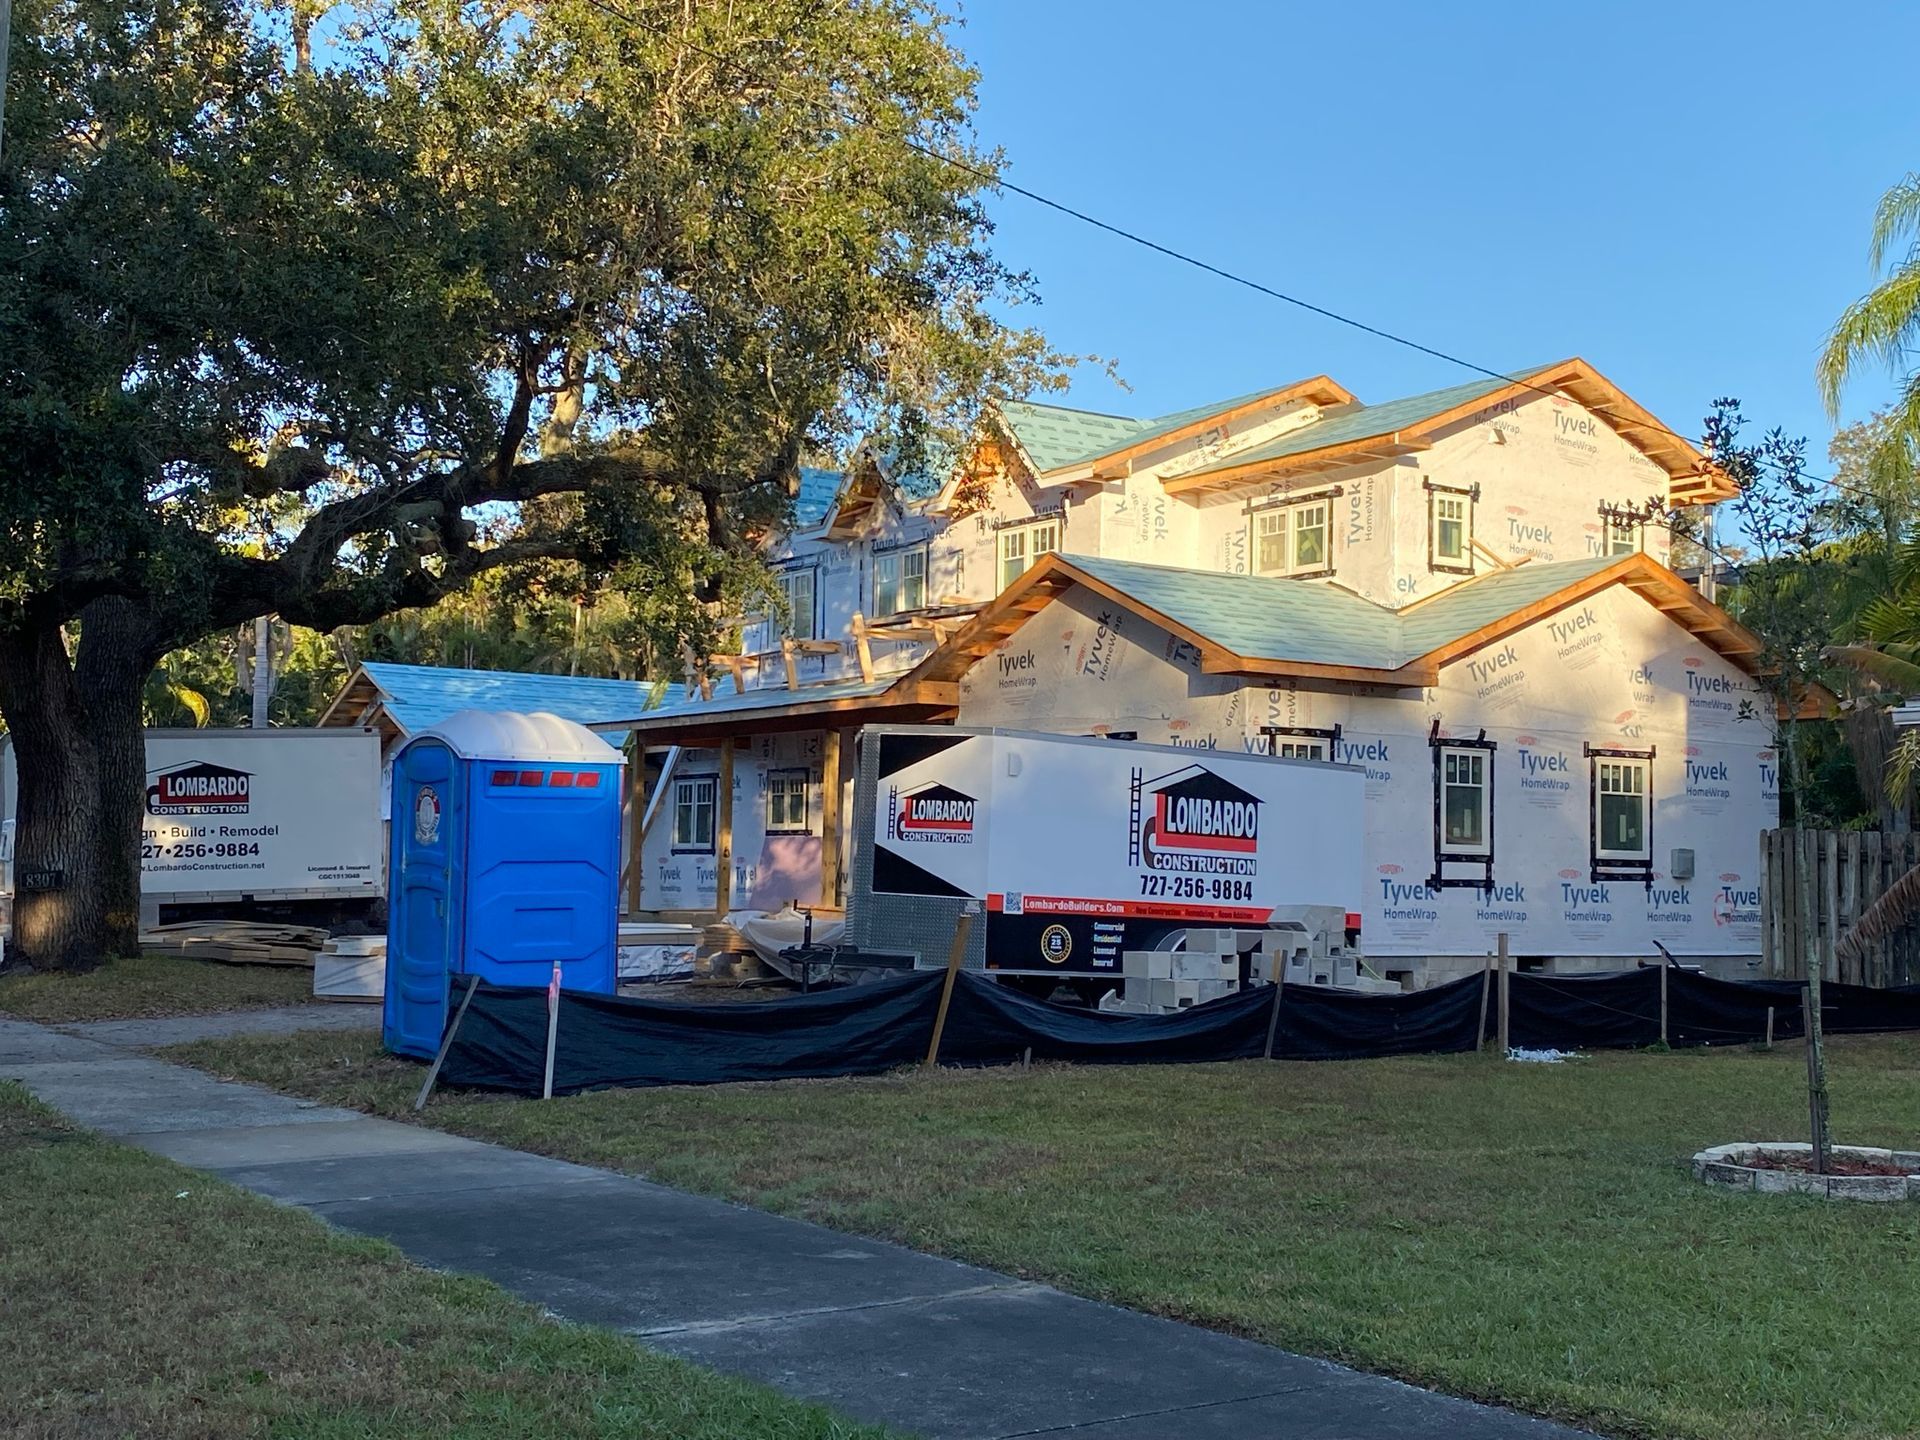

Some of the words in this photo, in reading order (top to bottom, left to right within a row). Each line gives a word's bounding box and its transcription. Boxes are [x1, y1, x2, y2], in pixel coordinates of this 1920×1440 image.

[1474, 414, 1520, 435] HomeWrap
[1553, 410, 1597, 438] Tyvek
[1554, 434, 1598, 454] HomeWrap
[1348, 482, 1361, 549] Tyvek
[1507, 518, 1553, 544] Tyvek
[1232, 524, 1247, 573] Tyve
[1509, 543, 1555, 561] HomeWrap
[1547, 607, 1597, 644] Tyvek
[1083, 610, 1111, 675] Tyvek
[1557, 631, 1602, 659] HomeWrap
[997, 649, 1035, 677] Tyvek
[1466, 645, 1518, 683] Tyvek
[998, 676, 1037, 688] HomeWrap
[1477, 670, 1525, 699] HomeWrap
[1685, 671, 1731, 696] Tyvek
[1633, 691, 1656, 704] Wrap
[1688, 698, 1733, 712] HomeWrap
[1226, 694, 1239, 727] Wrap
[1335, 737, 1388, 763] Tyvek
[1518, 750, 1568, 775] Tyvek
[1684, 760, 1727, 784] Tyvek
[168, 776, 248, 797] LOMBARDO
[1365, 769, 1390, 782] Wrap
[1521, 777, 1570, 790] HomeWrap
[1686, 786, 1730, 799] HomeWrap
[151, 804, 248, 815] CONSTRUCTION
[912, 799, 973, 821] LOMBARDO
[1167, 796, 1256, 838] LOMBARDO
[171, 827, 206, 838] Build
[220, 825, 279, 837] Remodel
[903, 832, 972, 843] CONSTRUCTION
[142, 843, 260, 858] 27•256•9884
[659, 866, 681, 883] Tyvek
[1153, 853, 1256, 875] CONSTRUCTION
[26, 873, 56, 888] 8307
[1141, 875, 1252, 900] 727-256-9884
[1380, 879, 1436, 905] Tyvek
[1561, 883, 1609, 909] Tyvek
[1647, 885, 1690, 909] Tyvek
[1722, 886, 1761, 908] Tyve
[1024, 900, 1125, 914] LombardoBuilders.Com
[1384, 908, 1437, 921] HomeWrap
[1477, 909, 1527, 923] HomeWrap
[1564, 911, 1612, 923] HomeWrap
[1647, 912, 1692, 924] HomeWrap
